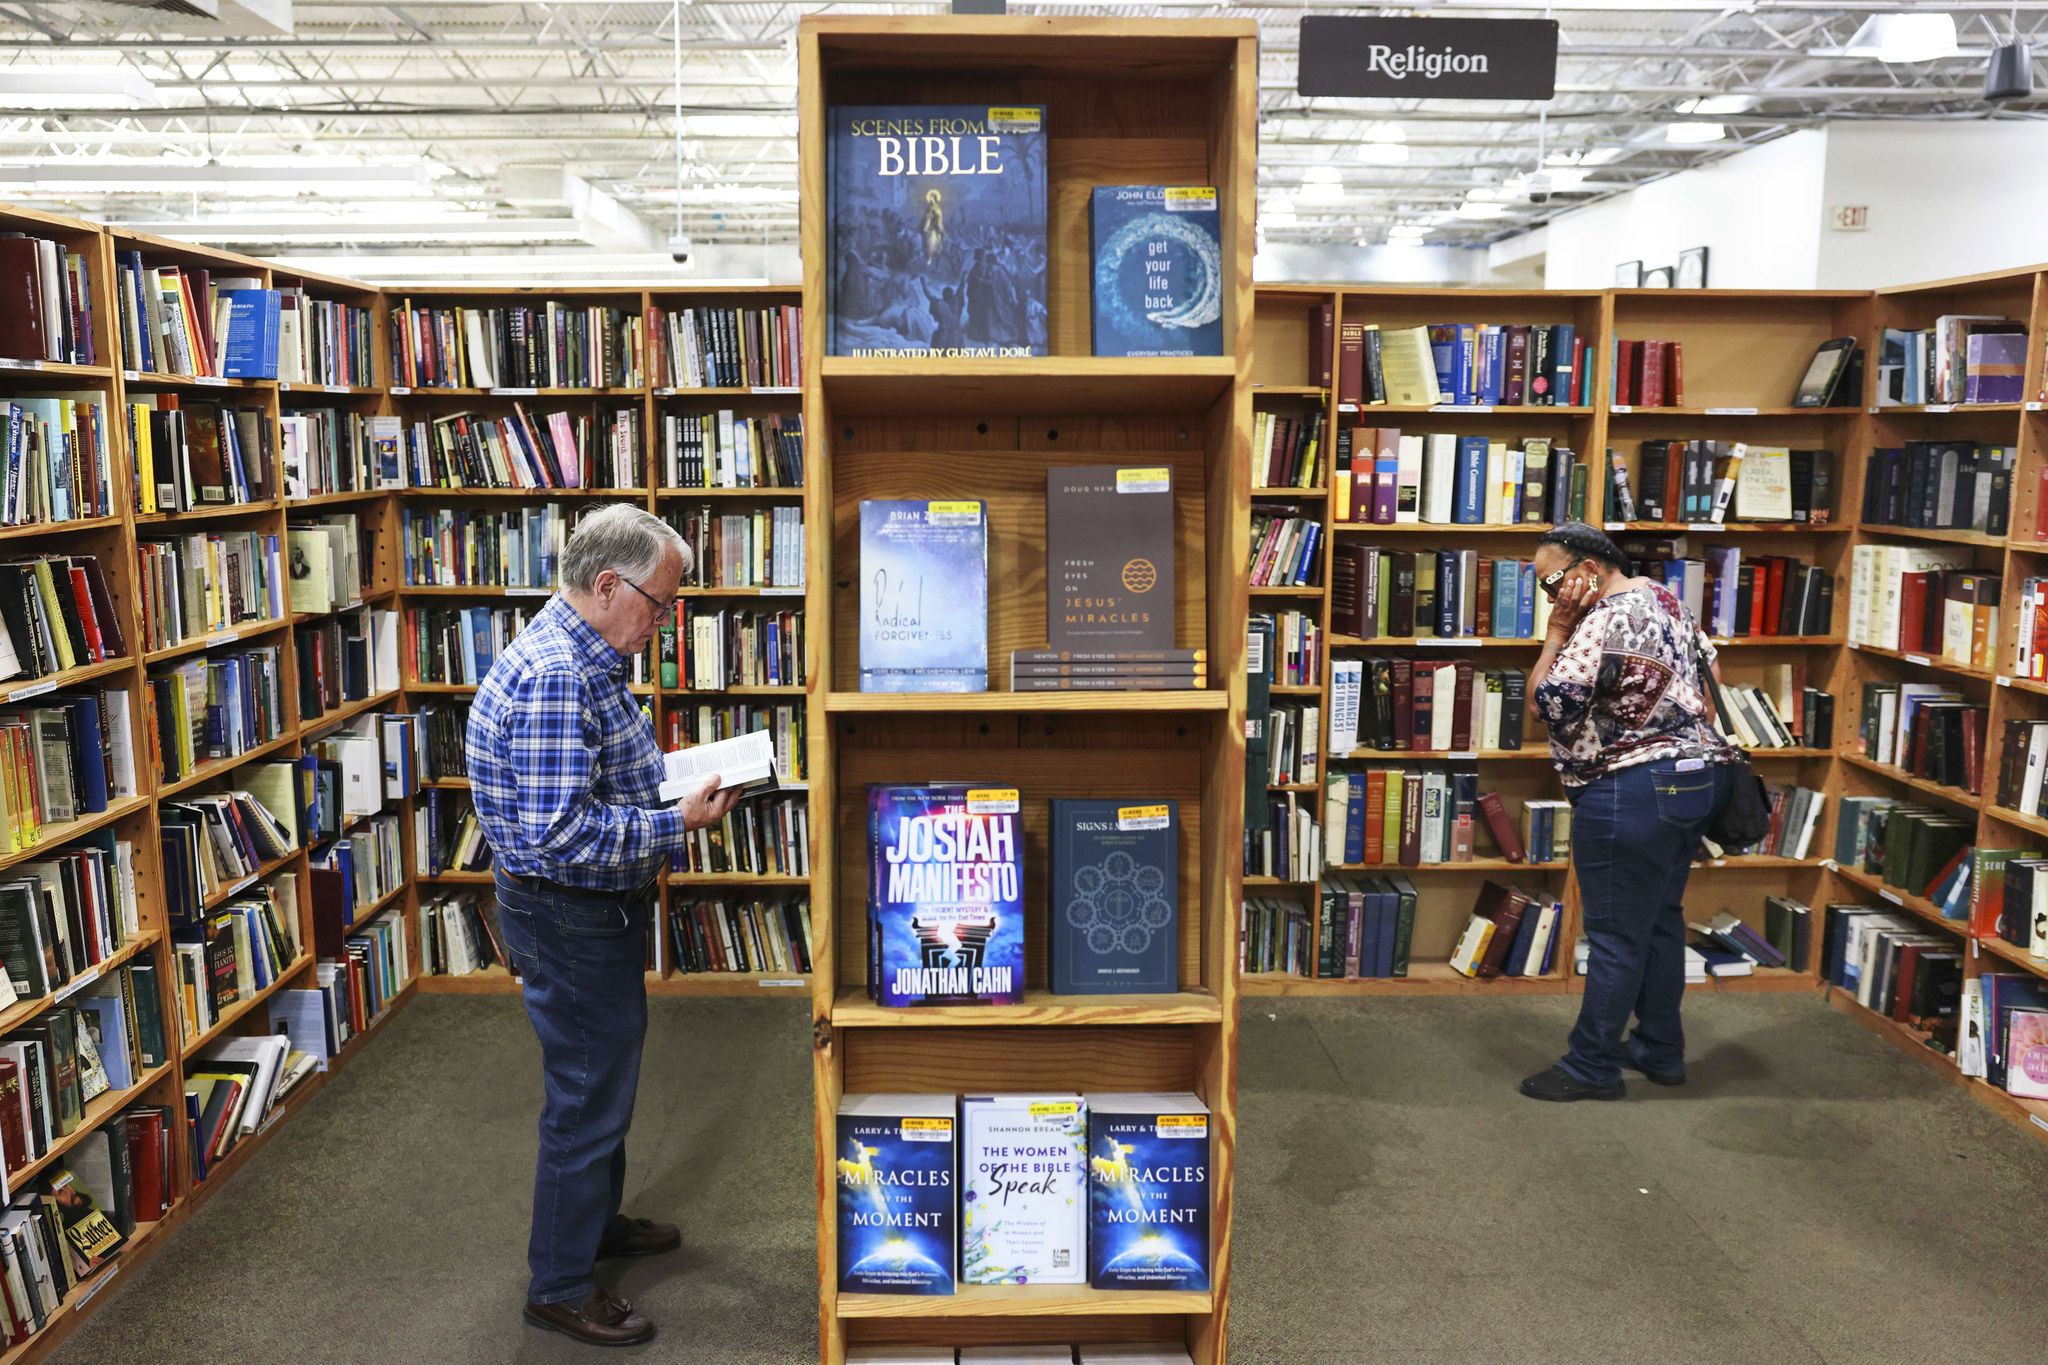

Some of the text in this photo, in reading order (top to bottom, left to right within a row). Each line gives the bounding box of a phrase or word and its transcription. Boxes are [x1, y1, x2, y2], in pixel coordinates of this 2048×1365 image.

[1367, 45, 1489, 79] Religion
[851, 119, 924, 137] SCENES
[929, 118, 985, 136] FROM
[877, 136, 1004, 176] BIBLE
[1116, 191, 1144, 200] JOHN
[1149, 241, 1167, 256] get
[1145, 261, 1171, 274] your
[1149, 276, 1168, 290] life
[1145, 294, 1173, 308] back
[605, 344, 611, 356] OF
[852, 345, 1032, 358] ILLUSTRATED BY GUSTAVE DORÉ
[11, 423, 20, 454] Johnson
[620, 430, 628, 454] Search
[220, 421, 231, 473] TESTAMENT
[1467, 450, 1480, 511] Bible Commentary
[890, 511, 919, 520] BRIAN
[874, 568, 923, 627] Radical
[1066, 612, 1150, 623] MIRACLES
[1334, 684, 1346, 732] STRONGEST
[1346, 684, 1359, 732] STRONGEST
[944, 805, 965, 815] THE
[1076, 823, 1107, 831] SIGNS
[886, 815, 1015, 863] JOSIAH
[888, 862, 1018, 903] MANIFESTO
[892, 966, 1012, 995] JONATHAN CAHN
[983, 1147, 1067, 1156] THE WOMEN
[980, 1163, 1071, 1173] OF THE BIBLE
[1100, 1167, 1205, 1182] MIRACLES
[845, 1170, 950, 1186] MIRACLES
[989, 1164, 1060, 1207] Speak
[853, 1213, 942, 1227] MOMENT
[1108, 1209, 1198, 1223] MOMENT
[70, 1216, 114, 1251] Luther
